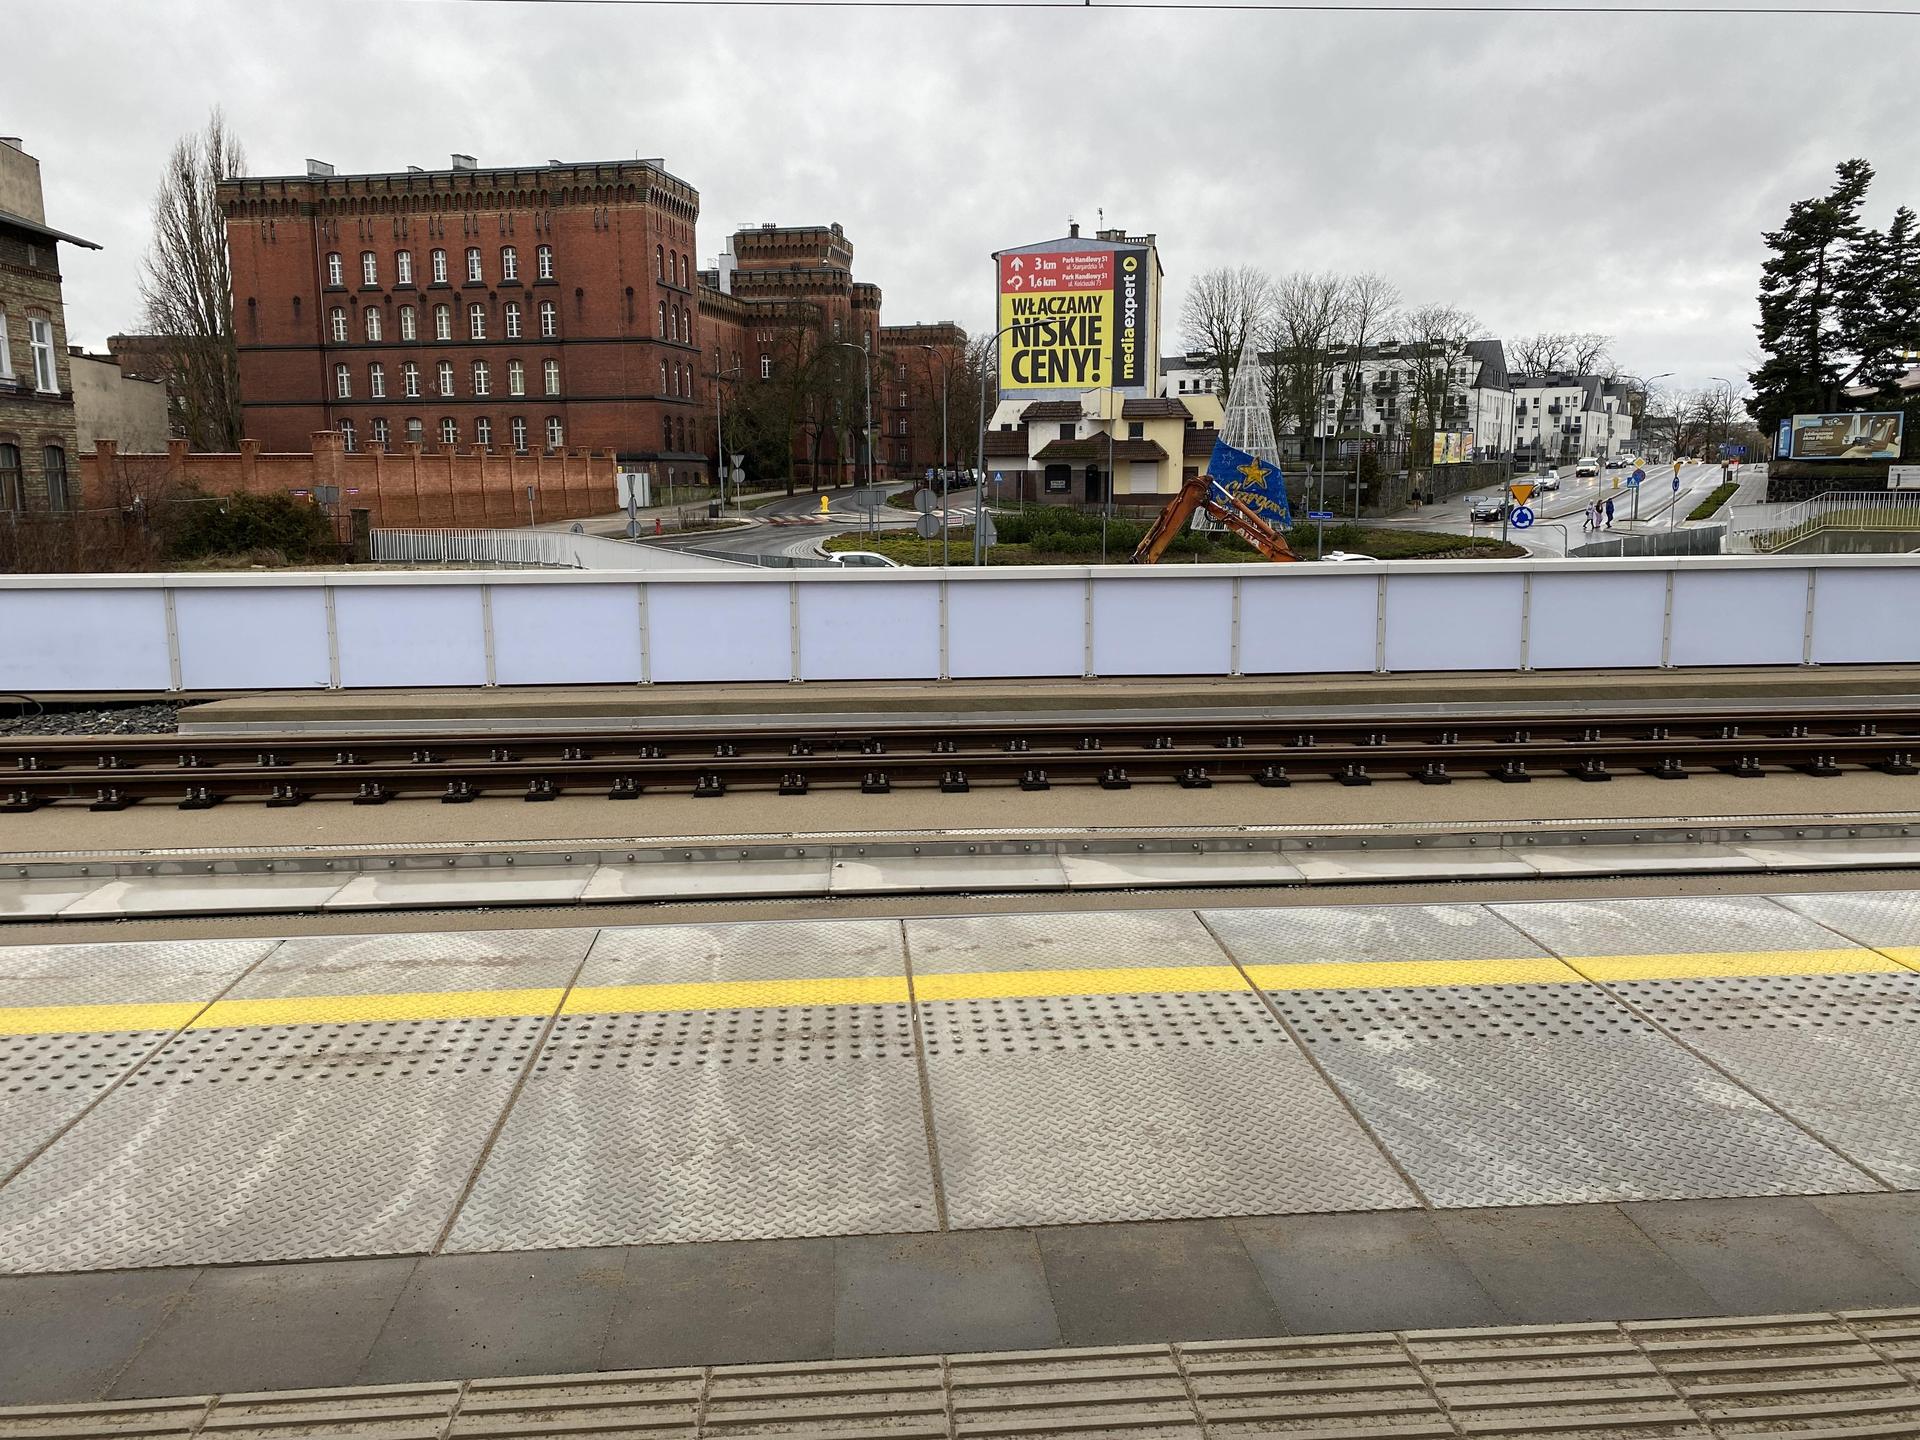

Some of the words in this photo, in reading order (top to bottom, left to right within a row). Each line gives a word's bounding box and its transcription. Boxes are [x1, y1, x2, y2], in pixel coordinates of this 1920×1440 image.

[1035, 258, 1041, 270] 3
[1043, 260, 1056, 270] km
[1028, 273, 1042, 288] 1,6
[1043, 276, 1056, 286] km
[1011, 296, 1103, 317] WŁĄCZAMY
[1011, 316, 1103, 348] NISKIE
[1121, 274, 1138, 379] mediaexpert
[1011, 347, 1102, 384] CENY!
